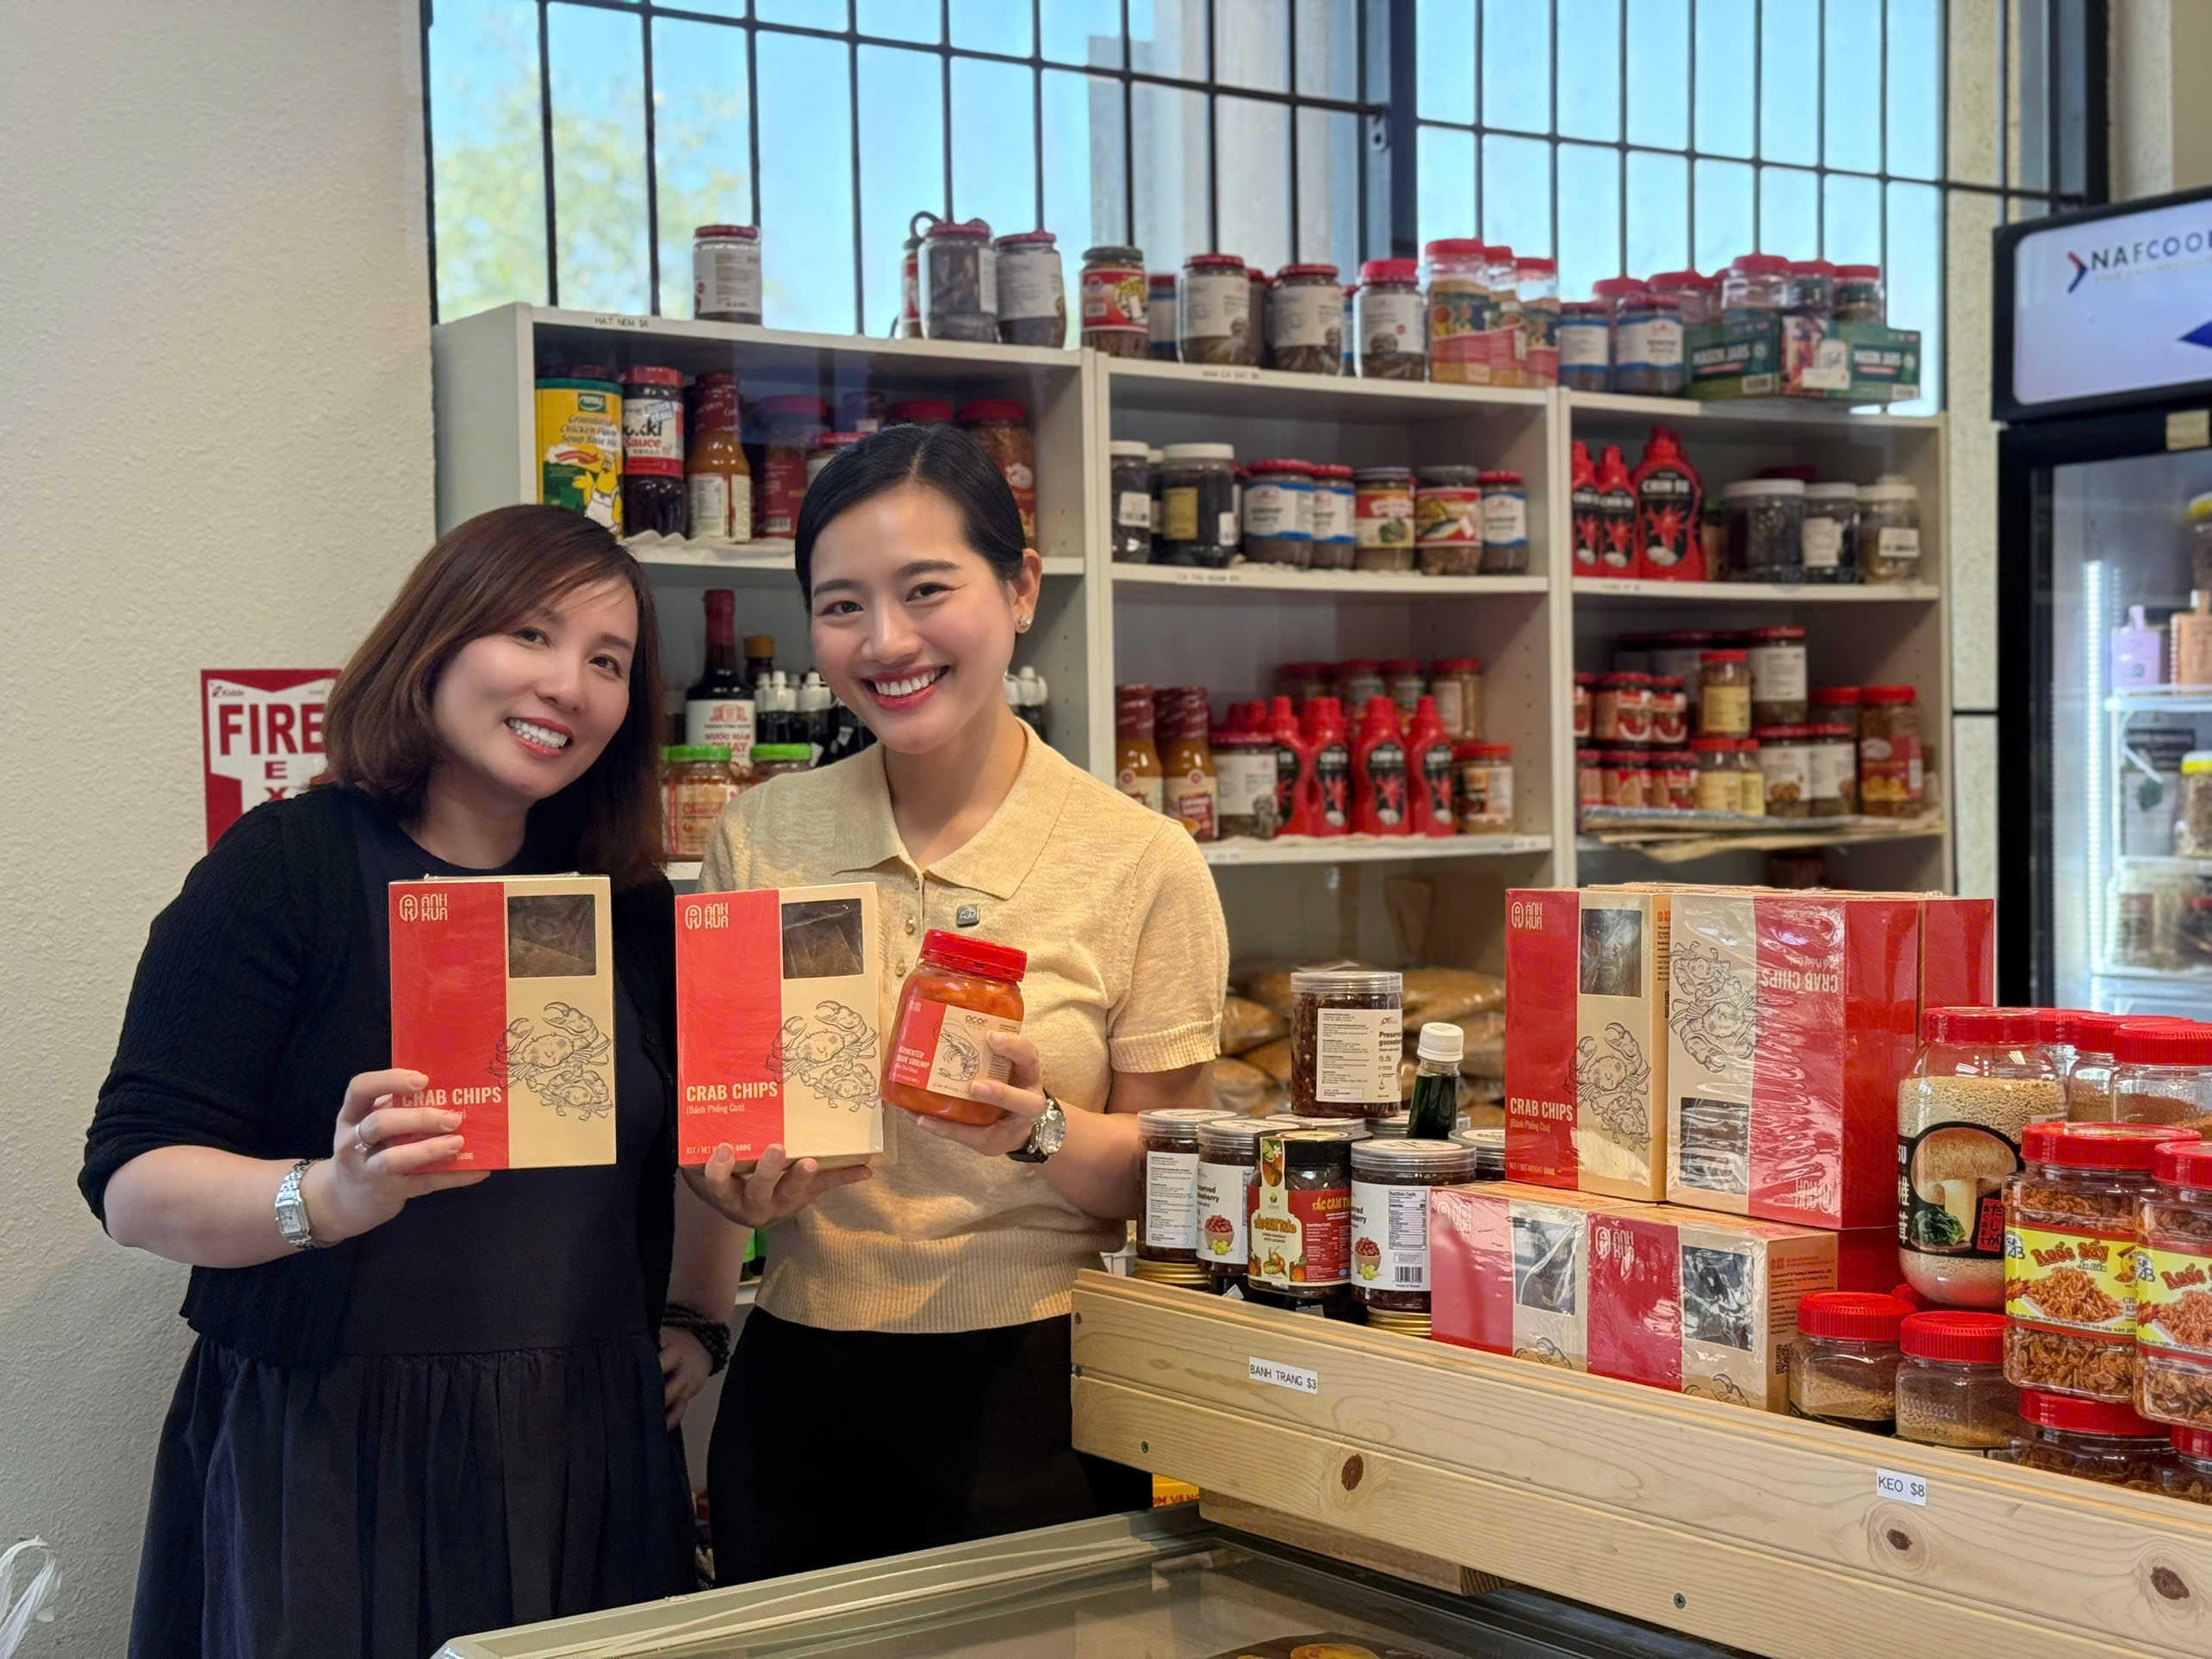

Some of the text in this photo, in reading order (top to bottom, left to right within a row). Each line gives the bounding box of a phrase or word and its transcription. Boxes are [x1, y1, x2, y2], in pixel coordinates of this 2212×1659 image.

[218, 703, 327, 756] FIRE
[1805, 972, 1838, 993] CRAB
[452, 1085, 502, 1105] CHIPS
[686, 1081, 779, 1102] CRAB CHIPS
[1510, 1097, 1573, 1122] CRAB CHIPS
[2030, 1238, 2110, 1267] Ruốc Sấy
[2160, 1262, 2207, 1290] Ruốc
[1250, 1364, 1317, 1389] BANH TRANG $3
[1879, 1476, 1925, 1497] KEO $8
